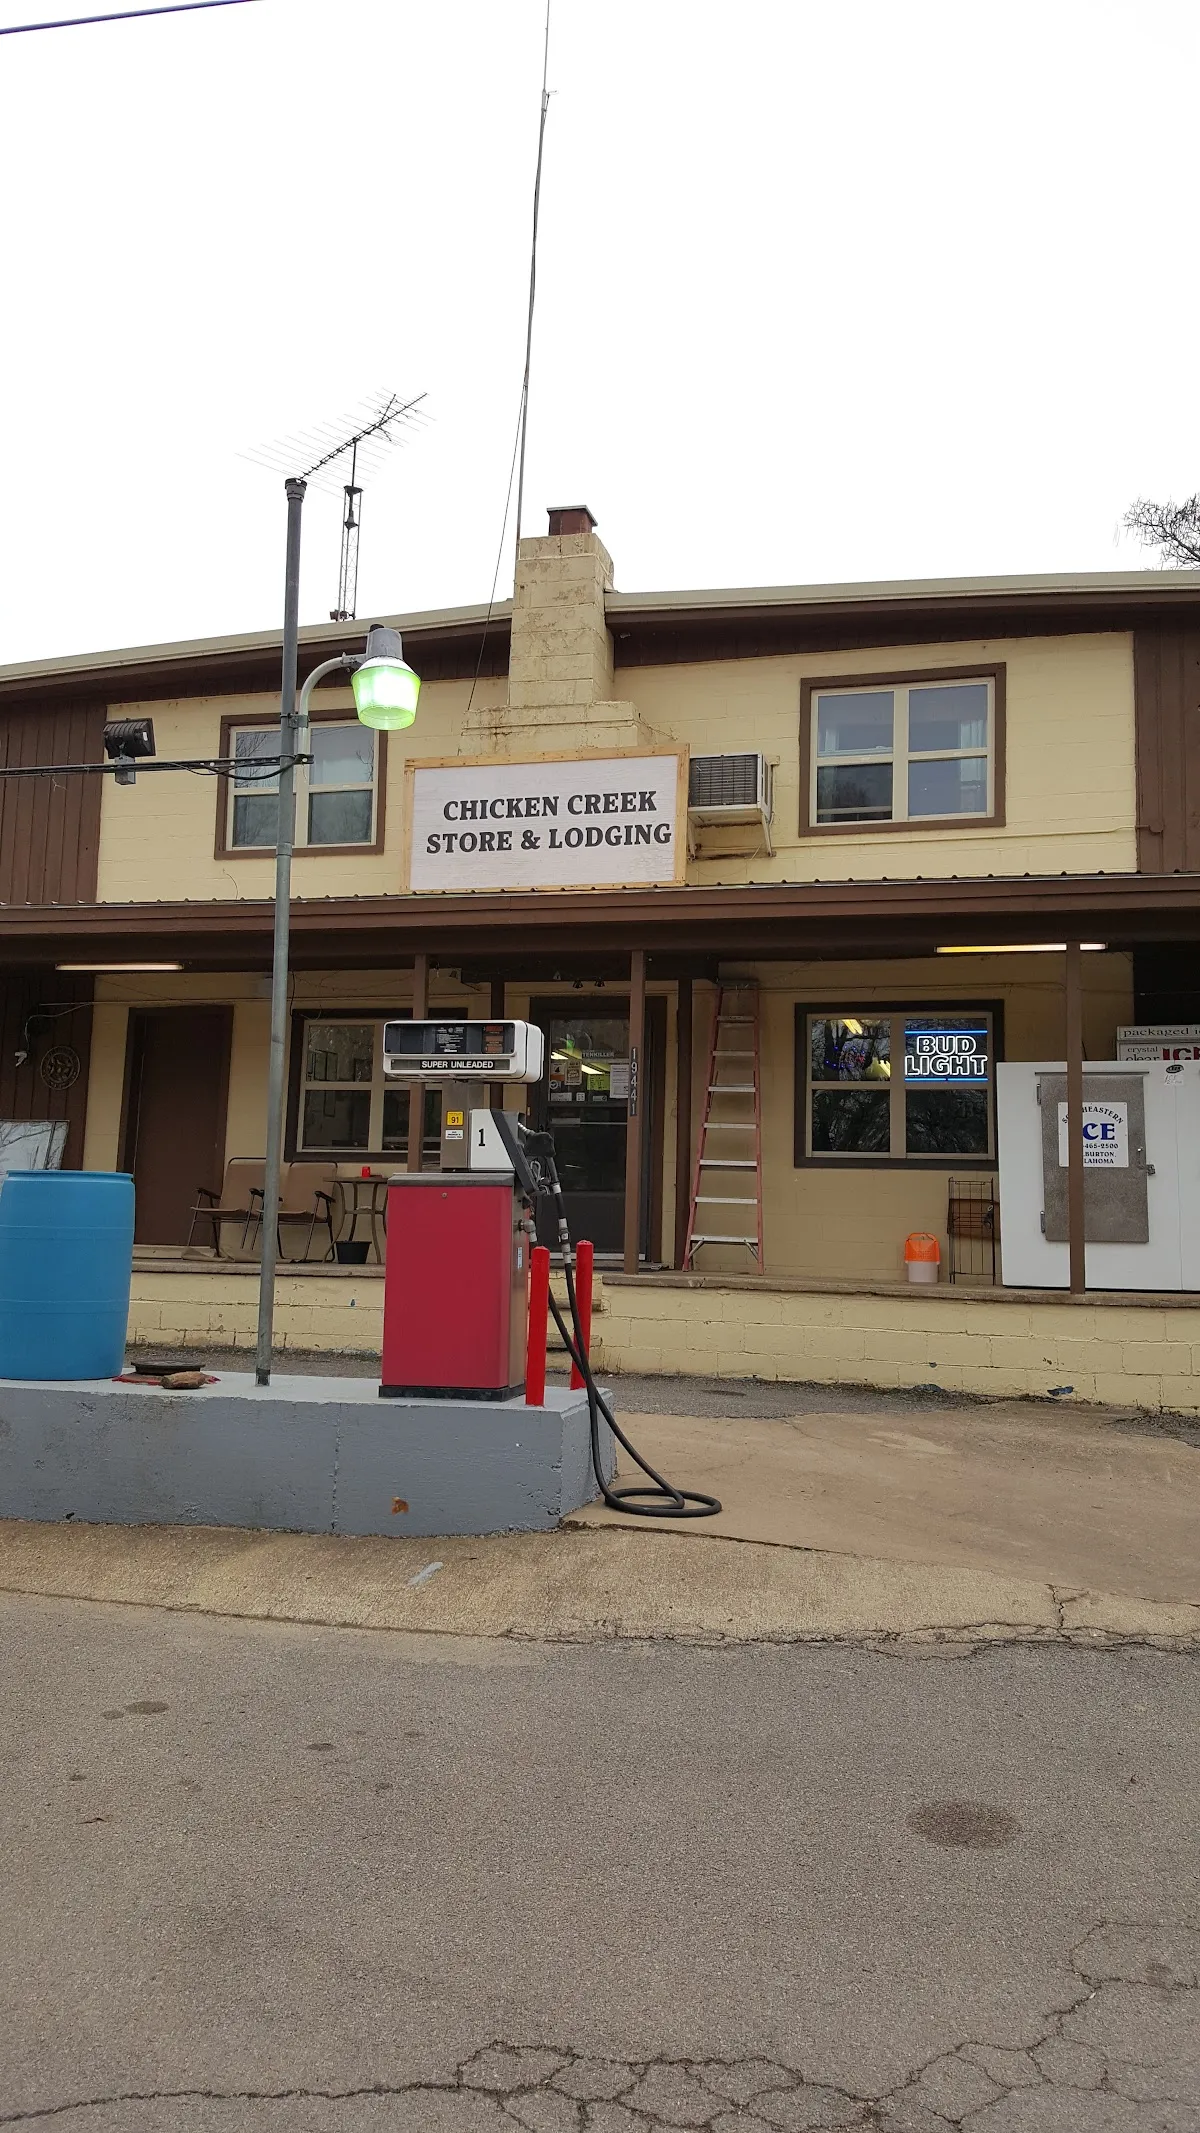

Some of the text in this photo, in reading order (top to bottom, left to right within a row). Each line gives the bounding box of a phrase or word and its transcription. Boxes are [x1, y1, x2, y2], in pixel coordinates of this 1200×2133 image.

[443, 790, 657, 821] CHICKEN CREEK
[426, 823, 672, 854] STORE & LODGING
[1124, 1028, 1189, 1037] packaged
[916, 1035, 976, 1055] BUD
[1127, 1046, 1158, 1054] crystal
[421, 1060, 494, 1069] SUPER UNLEADED
[904, 1055, 988, 1076] LIGHT
[451, 1116, 459, 1124] 91
[1061, 1105, 1124, 1124] SHEASTERN
[478, 1128, 486, 1147] 1
[1082, 1123, 1115, 1140] CE
